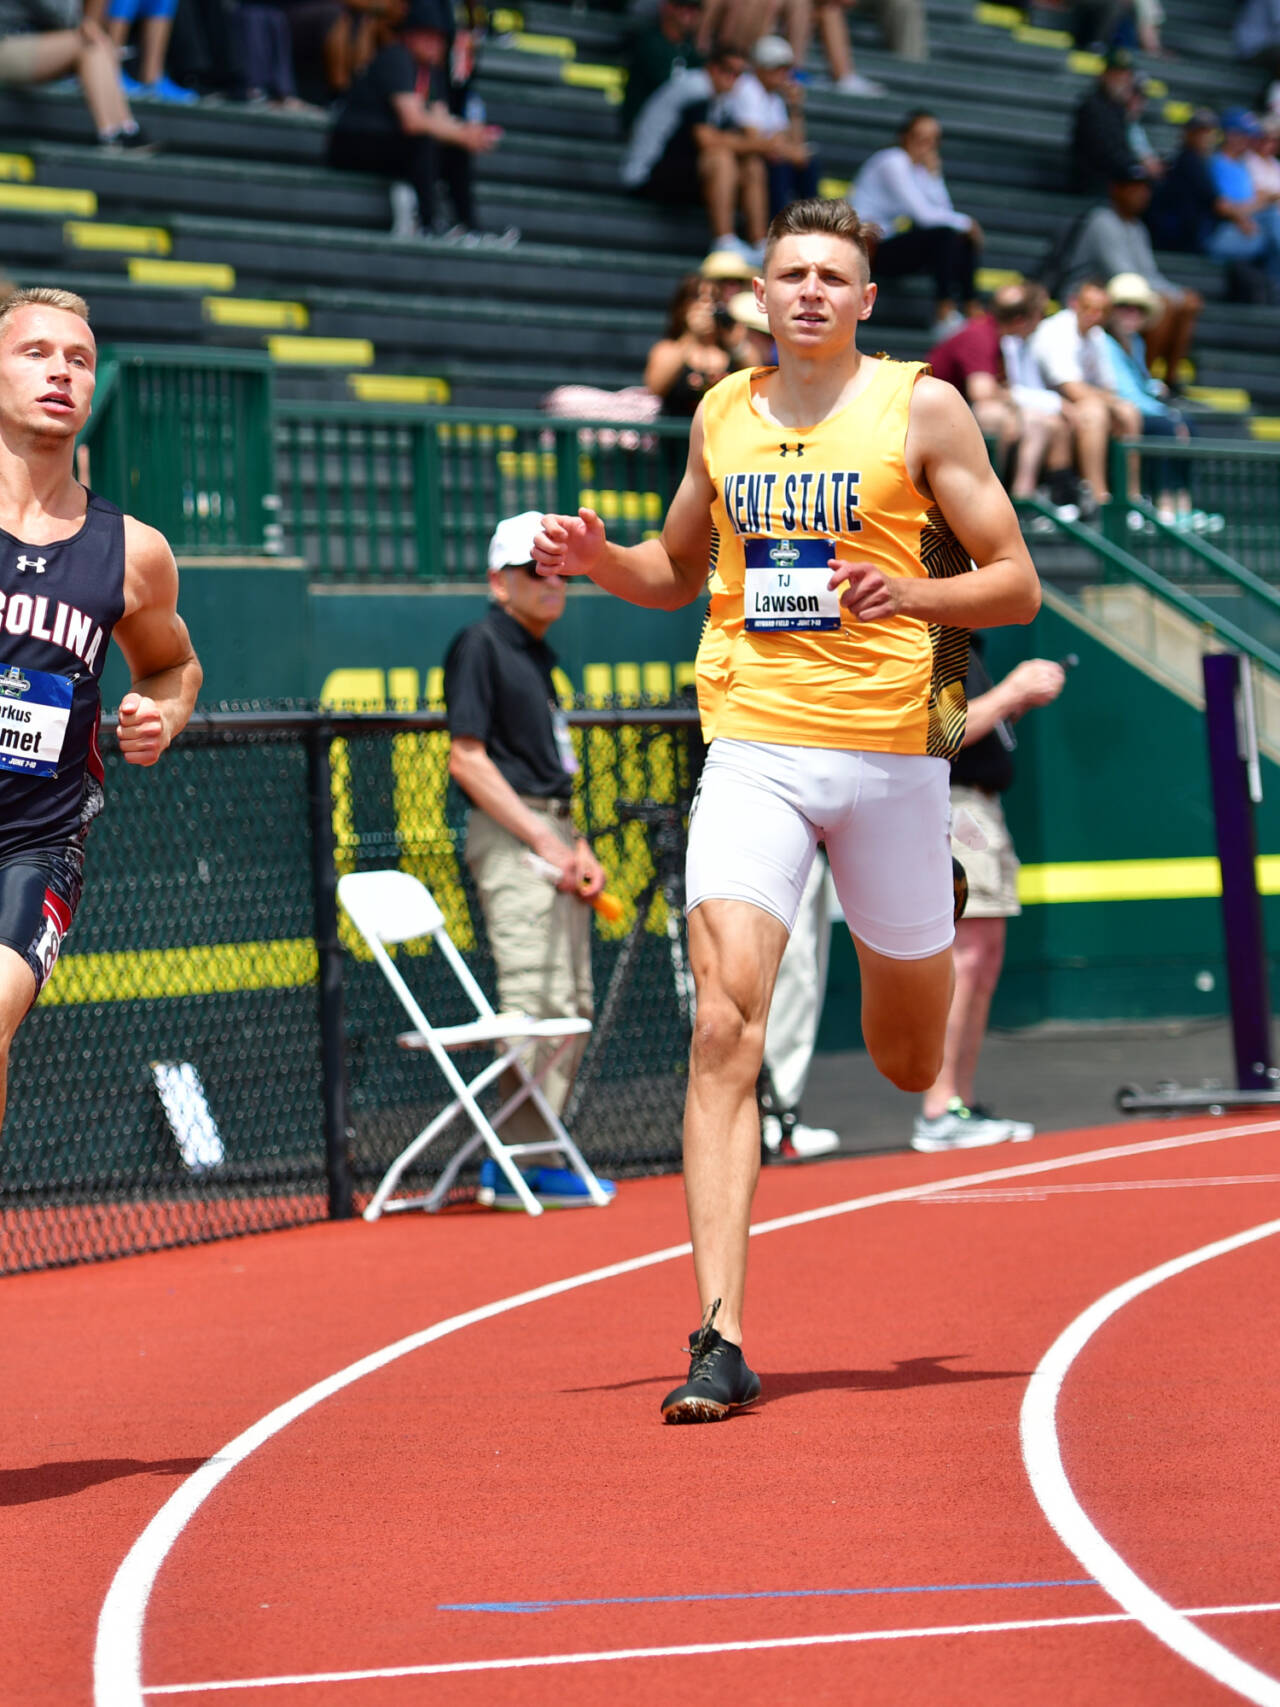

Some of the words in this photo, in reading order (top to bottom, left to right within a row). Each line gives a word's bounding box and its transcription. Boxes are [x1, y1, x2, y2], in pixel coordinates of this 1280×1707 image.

[724, 474, 777, 535] KENT
[782, 472, 863, 533] STATE
[778, 574, 791, 588] TJ
[755, 592, 819, 612] Lawson
[8, 758, 24, 766] JUNE
